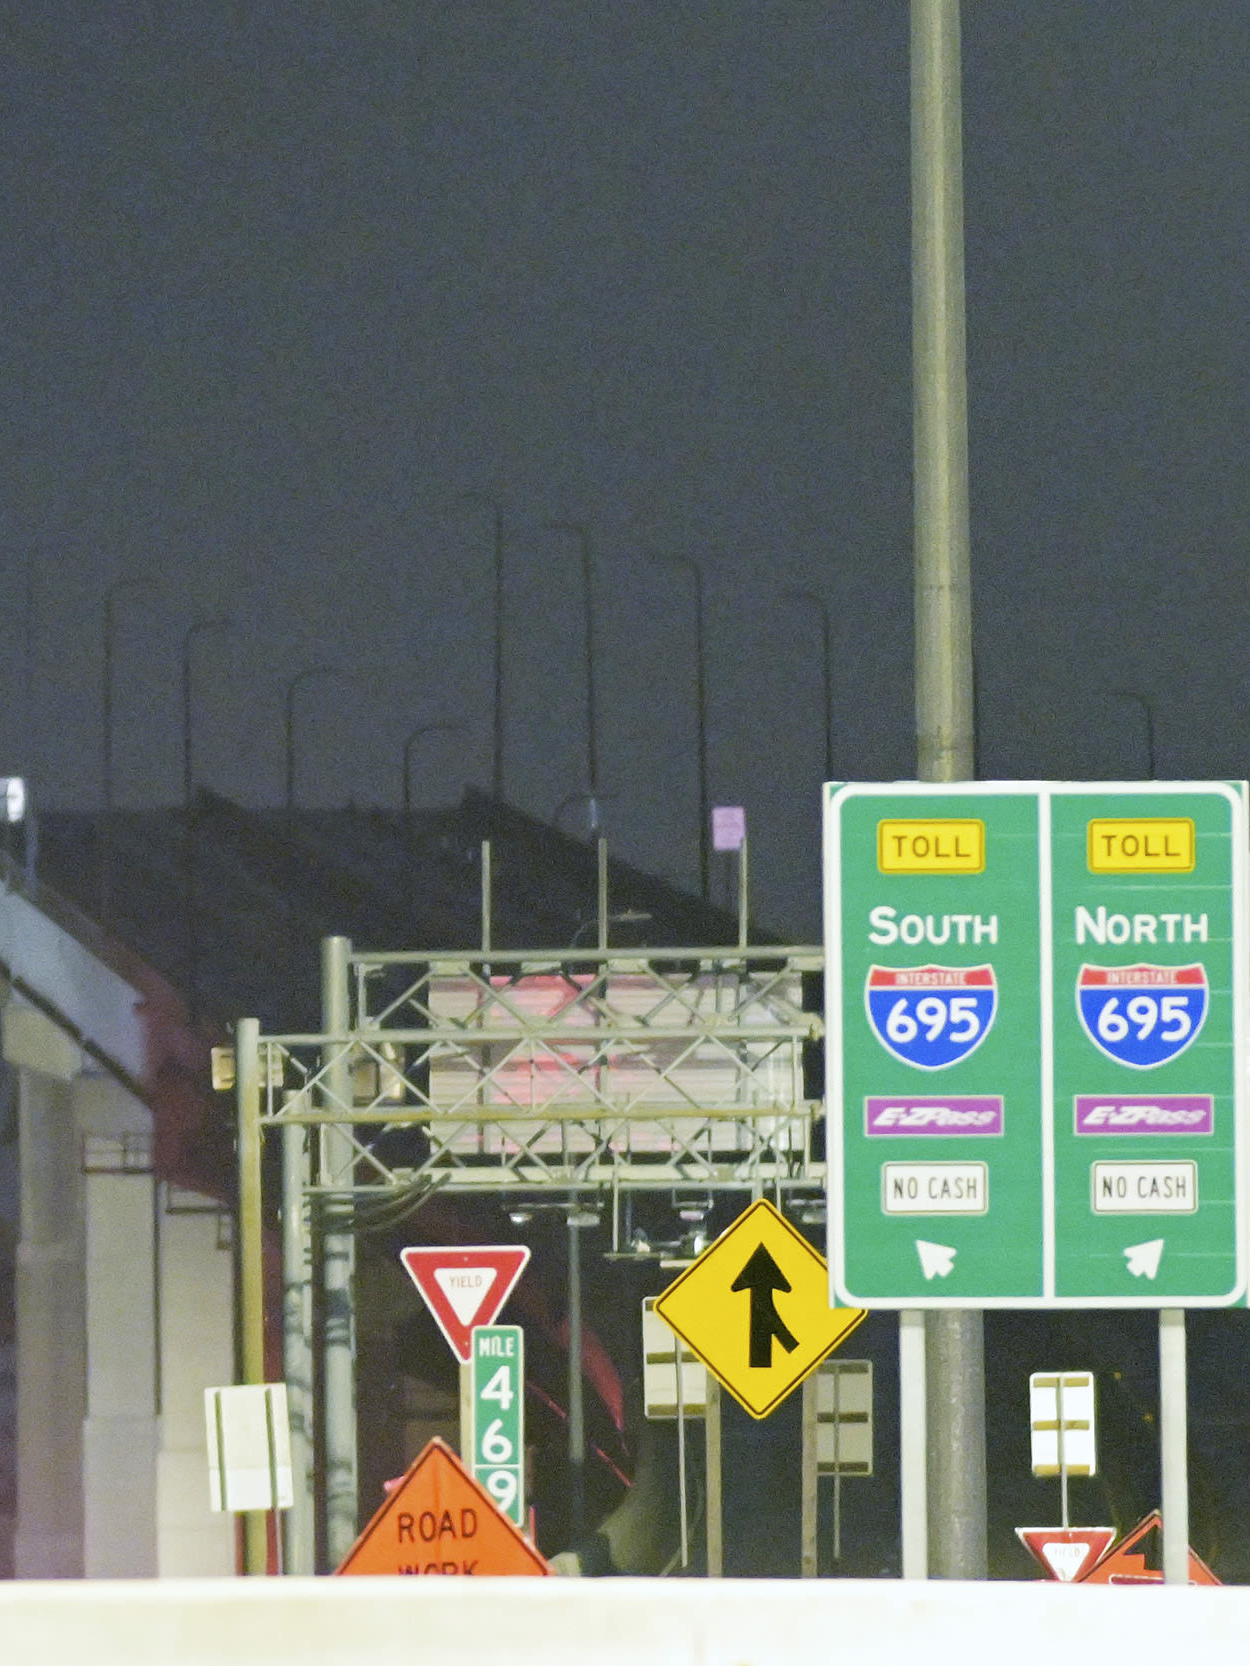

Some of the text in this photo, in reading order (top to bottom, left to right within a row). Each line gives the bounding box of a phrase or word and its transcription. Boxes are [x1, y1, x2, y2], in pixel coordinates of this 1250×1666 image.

[891, 835, 971, 858] TOLL
[1101, 834, 1182, 857] TOLL
[867, 905, 999, 946] SOUTH
[1074, 905, 1209, 945] NORTH
[895, 972, 968, 986] INTERSTATE
[1106, 970, 1177, 985] INTERSTATE
[886, 996, 981, 1044] 695
[1097, 995, 1192, 1043] 695
[893, 1176, 978, 1200] NO CASH
[1102, 1175, 1187, 1199] NO CASH
[449, 1274, 483, 1289] YIELD
[478, 1336, 516, 1358] MILE
[480, 1364, 515, 1411] 4
[481, 1418, 513, 1464] 6
[486, 1469, 518, 1514] 9
[397, 1507, 478, 1544] ROAD
